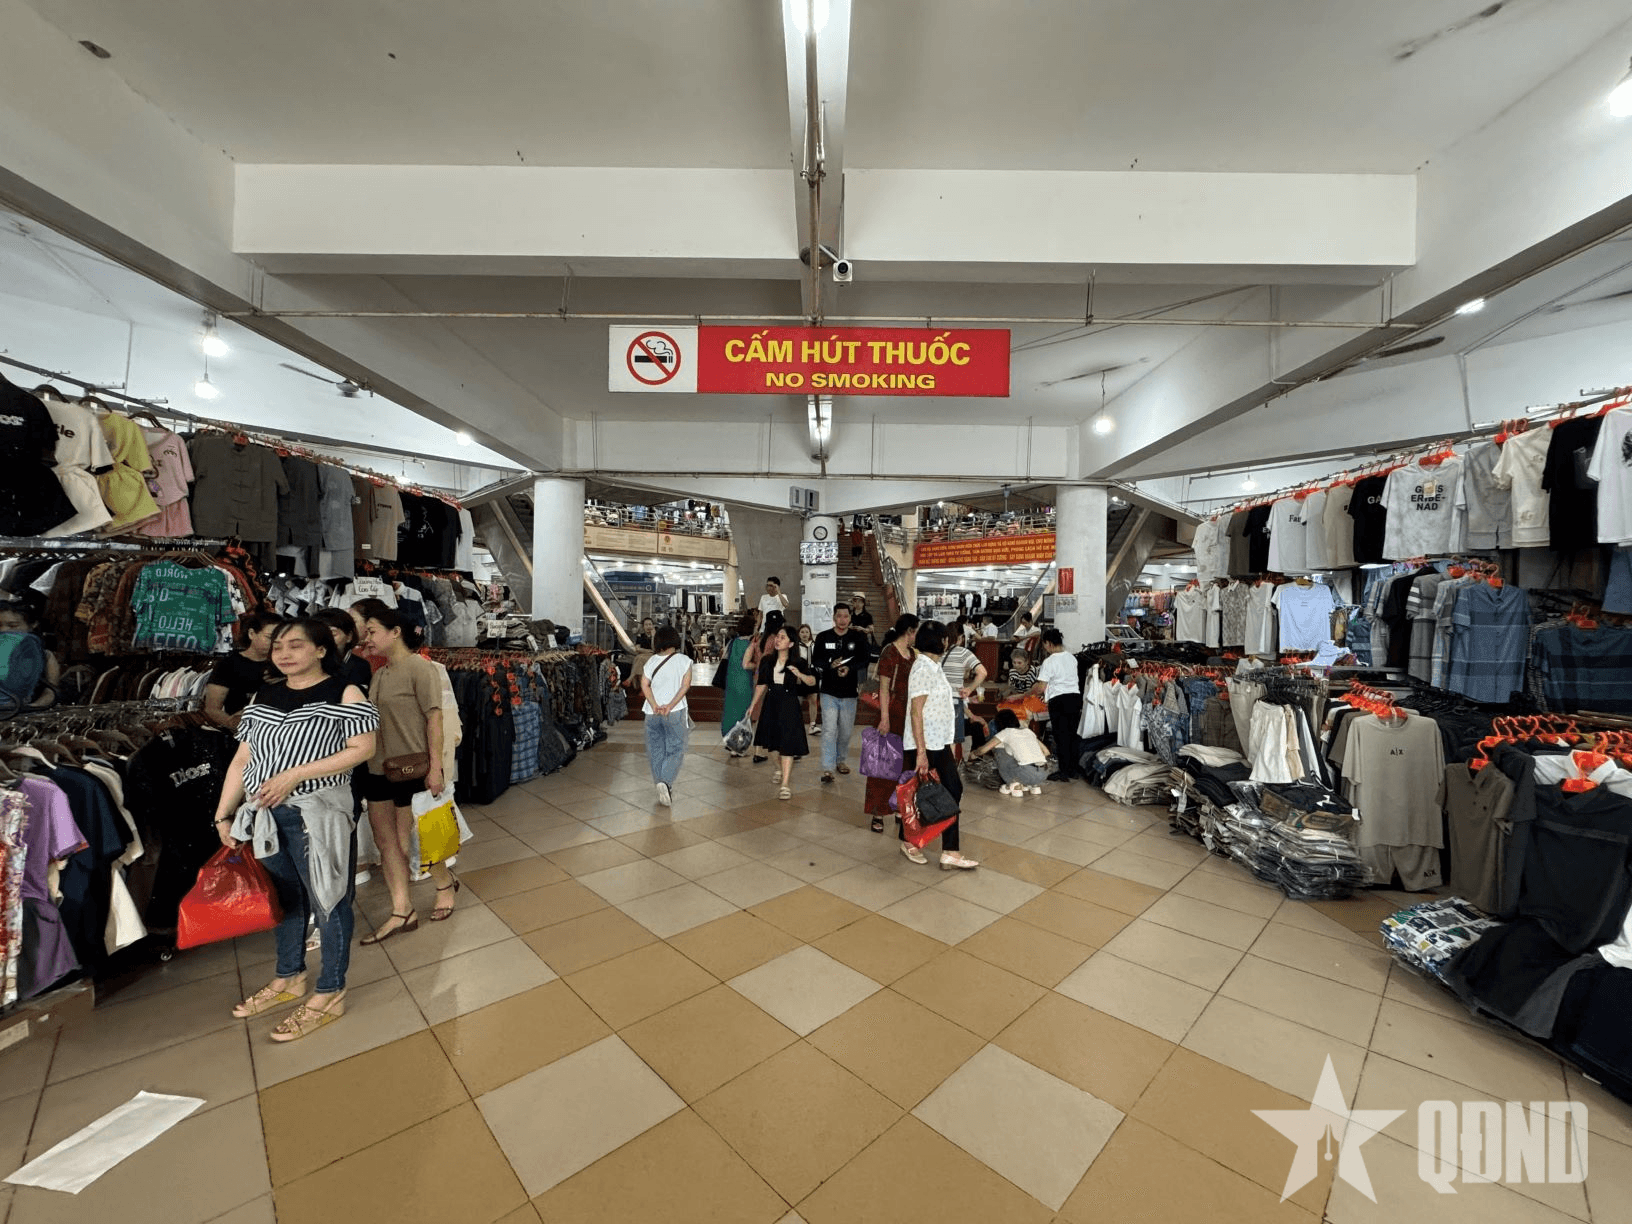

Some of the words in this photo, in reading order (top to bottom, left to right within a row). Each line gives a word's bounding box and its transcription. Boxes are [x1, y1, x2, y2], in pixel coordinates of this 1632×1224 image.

[725, 330, 792, 363] CẤM
[801, 334, 862, 364] HÚT
[867, 331, 971, 366] THUỐC
[765, 372, 805, 388] NO
[811, 373, 936, 389] SMOKING
[1415, 484, 1444, 493] GS
[1416, 502, 1439, 511] NAD
